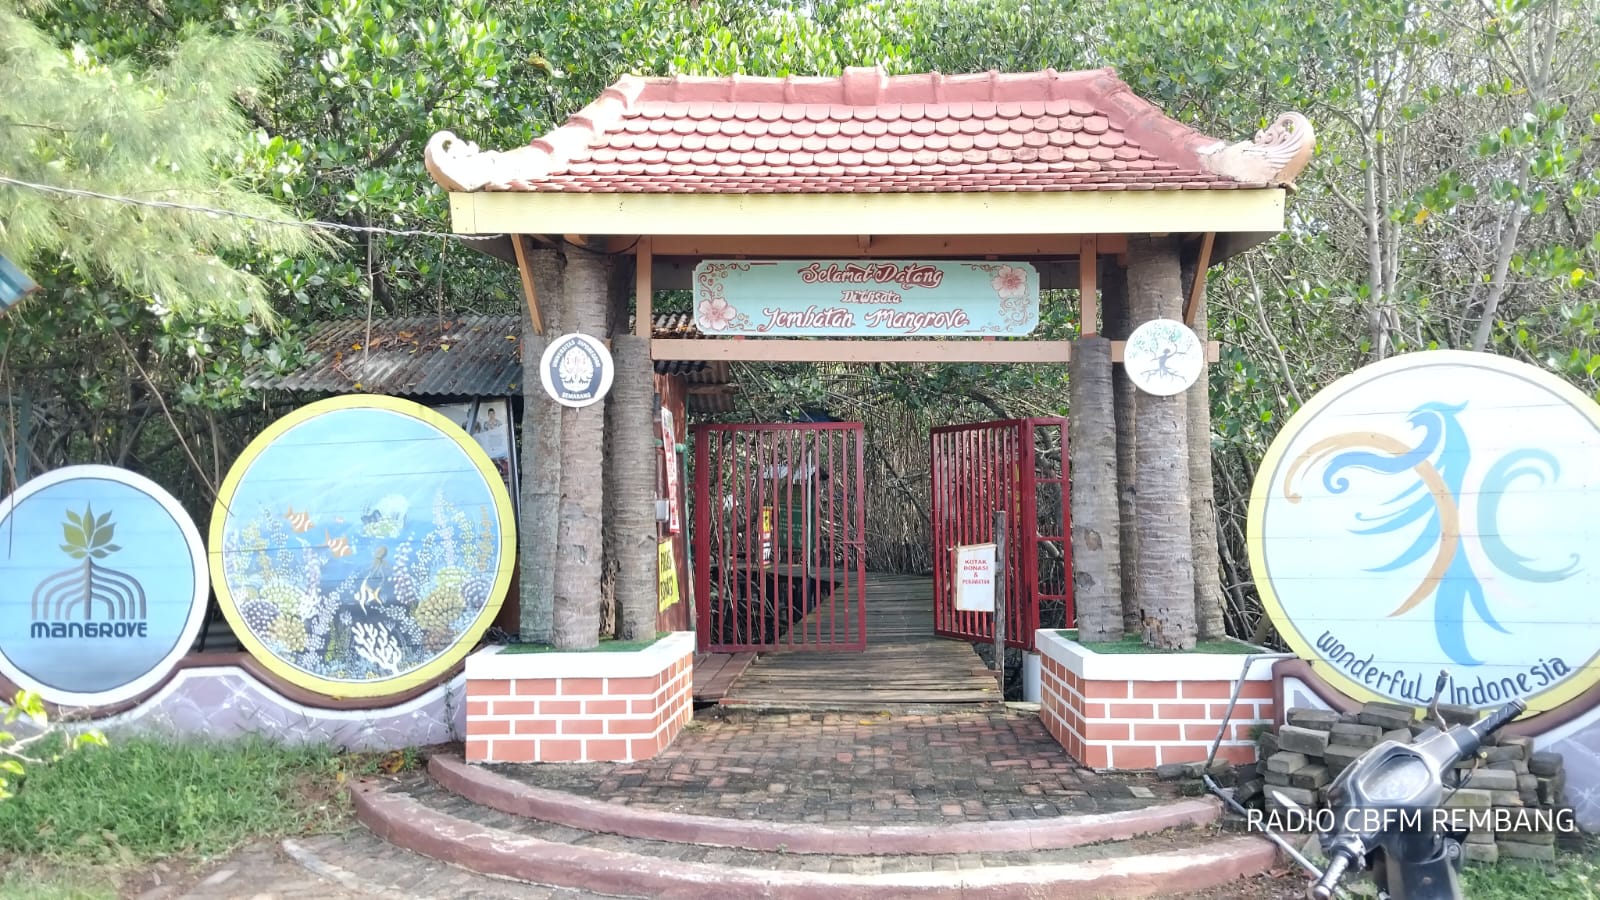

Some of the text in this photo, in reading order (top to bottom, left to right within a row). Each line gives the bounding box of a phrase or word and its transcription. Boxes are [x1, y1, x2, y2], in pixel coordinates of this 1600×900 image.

[798, 263, 944, 289] Selamat Datang
[859, 289, 903, 304] Wisata
[757, 305, 969, 334] Jembatan Mangrove
[1449, 656, 1571, 705] Indonesia
